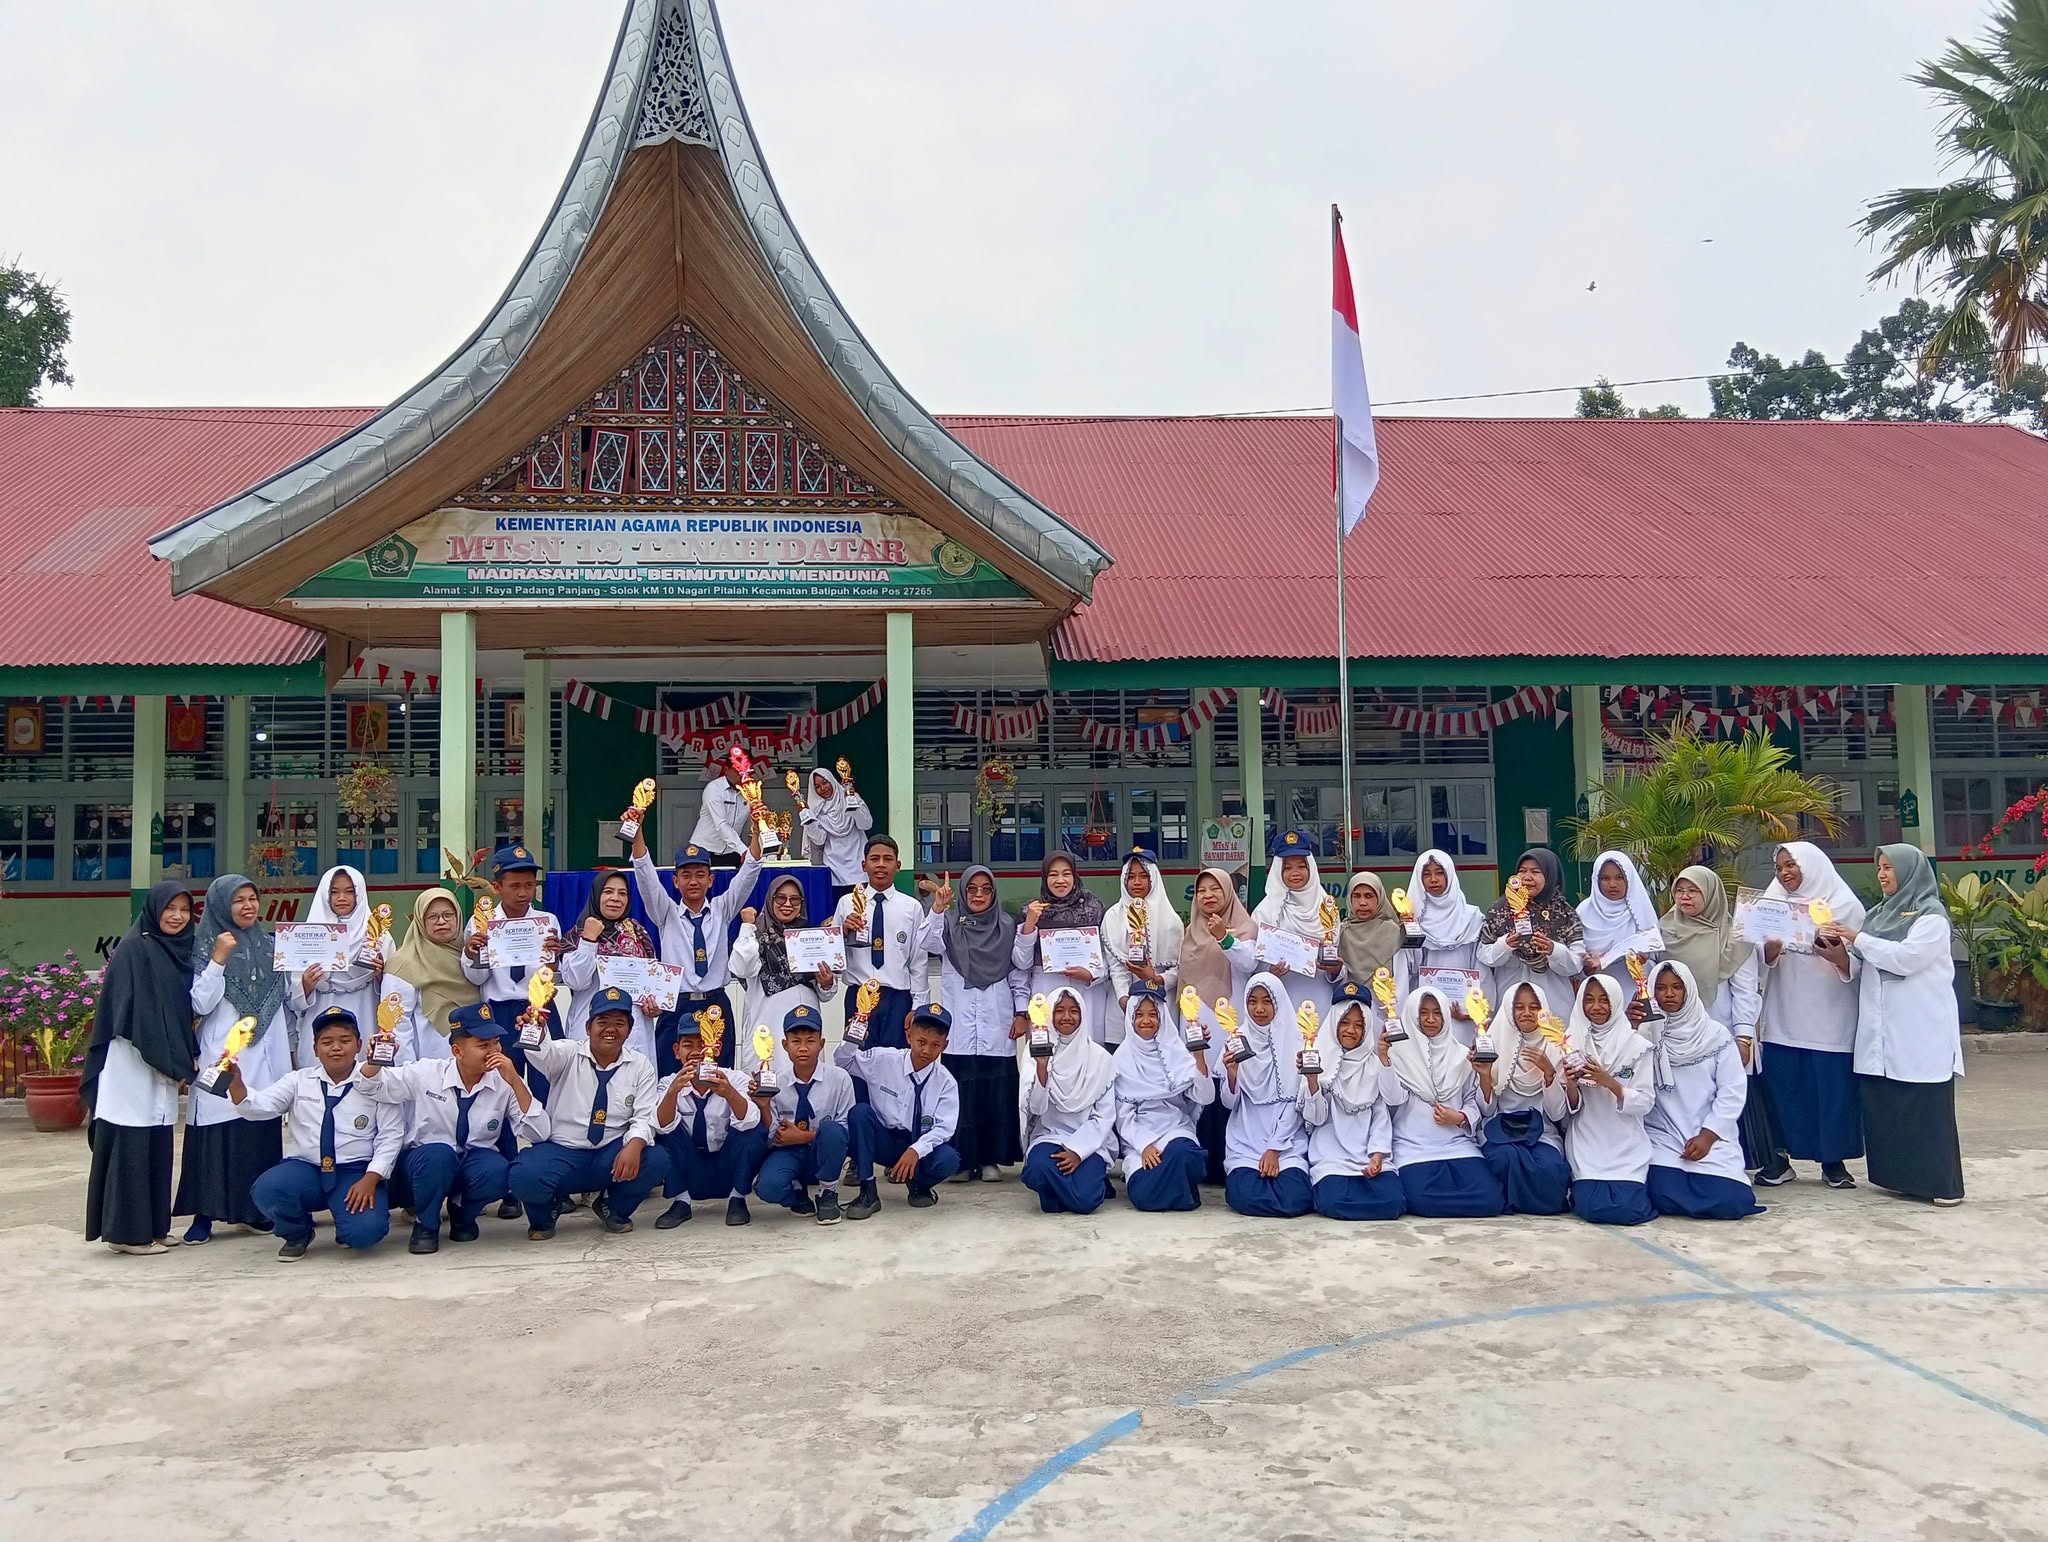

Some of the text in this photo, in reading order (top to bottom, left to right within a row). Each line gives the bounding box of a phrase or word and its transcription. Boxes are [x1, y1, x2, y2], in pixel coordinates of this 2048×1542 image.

[495, 518, 863, 534] KEMENTERIAN AGAMA REPUBLIK INDONESIA
[446, 535, 565, 565] MTsN
[632, 537, 770, 566] TANAH
[777, 537, 909, 566] DATAR
[467, 567, 891, 583] MADRASAH MAJU, BERMUTU DAN MENDUNIA
[422, 585, 460, 596] Alamat
[470, 586, 483, 596] Jl.
[486, 586, 512, 597] Raya
[515, 586, 555, 598] Padang
[558, 586, 601, 598] Panjang
[610, 586, 640, 595] Solok
[643, 587, 660, 595] KM
[662, 586, 675, 595] 10
[678, 586, 711, 598] Nagari
[714, 586, 749, 595] Pitalah
[752, 587, 808, 596] Kecamatan
[811, 587, 850, 599] Batipuh
[853, 587, 879, 596] Kode
[882, 587, 901, 596] Pos
[903, 587, 933, 596] 27265
